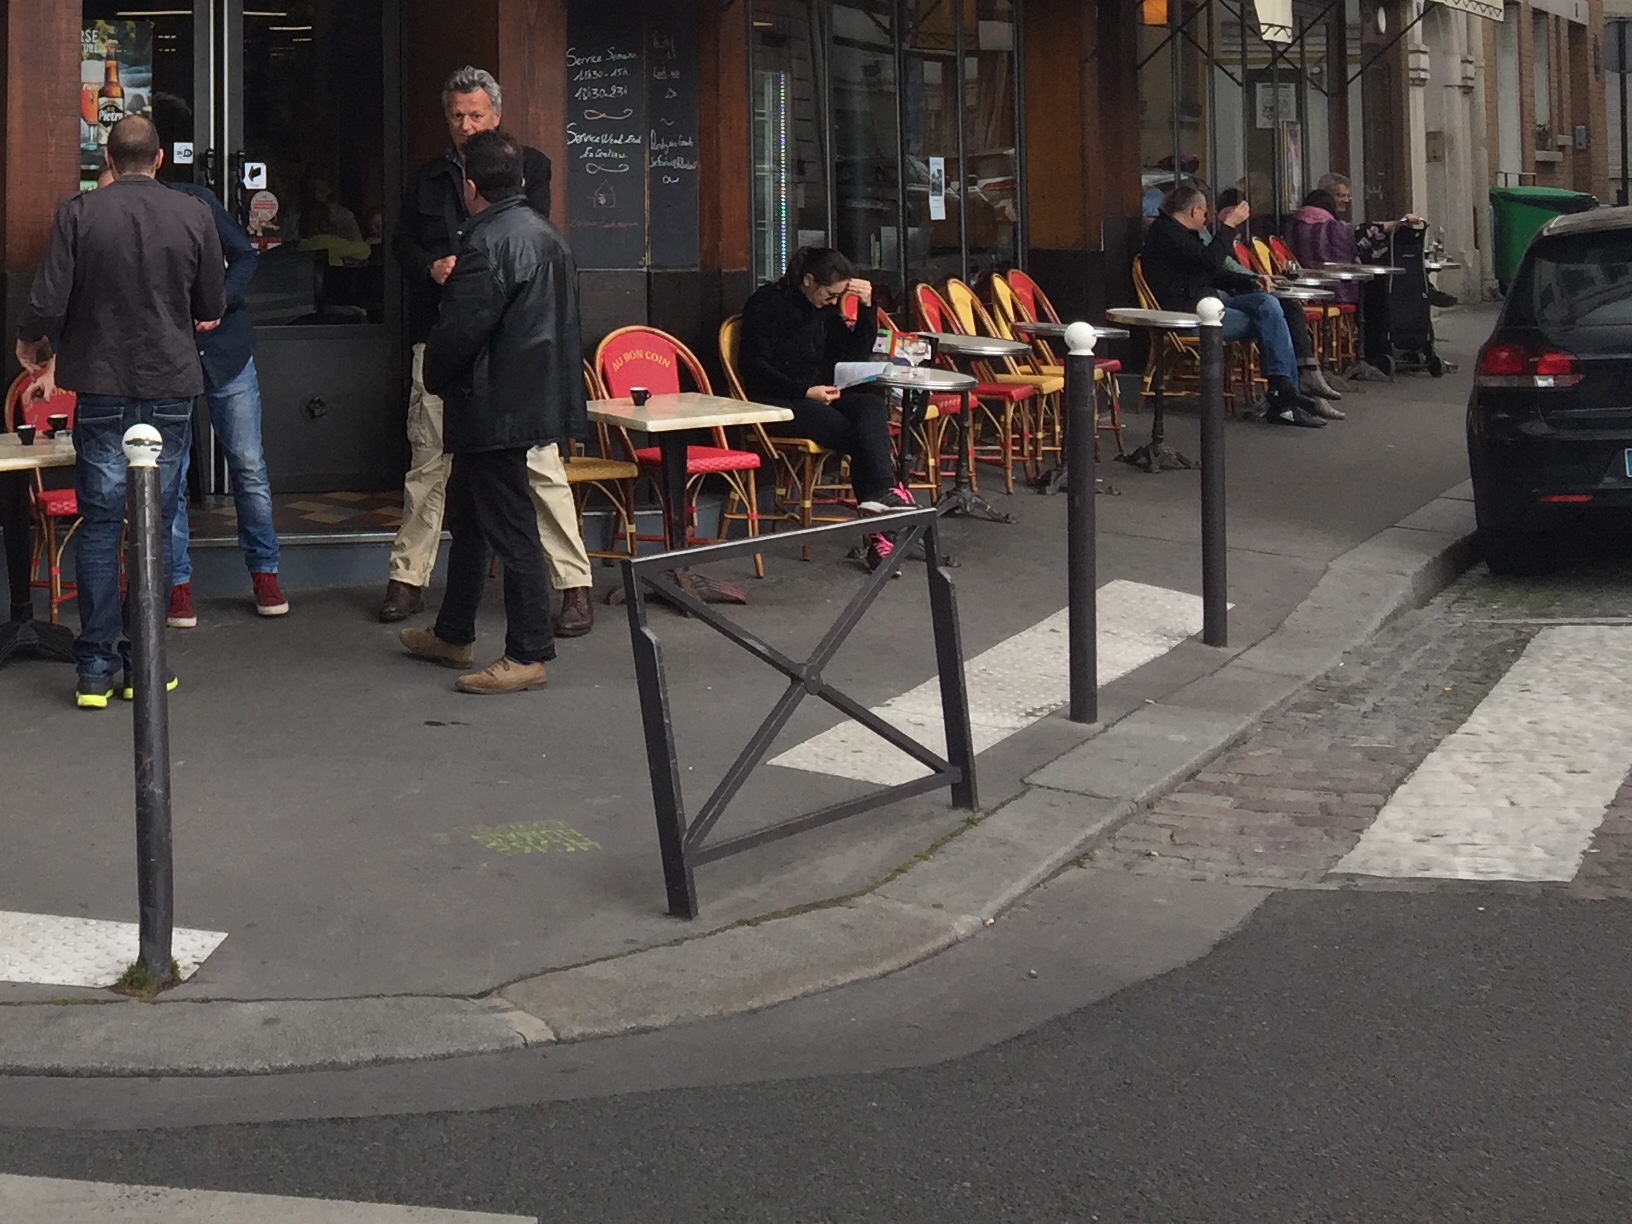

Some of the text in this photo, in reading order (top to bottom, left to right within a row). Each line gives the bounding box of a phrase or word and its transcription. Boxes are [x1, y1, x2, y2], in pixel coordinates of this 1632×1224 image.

[612, 350, 671, 372] AU BON COIN
